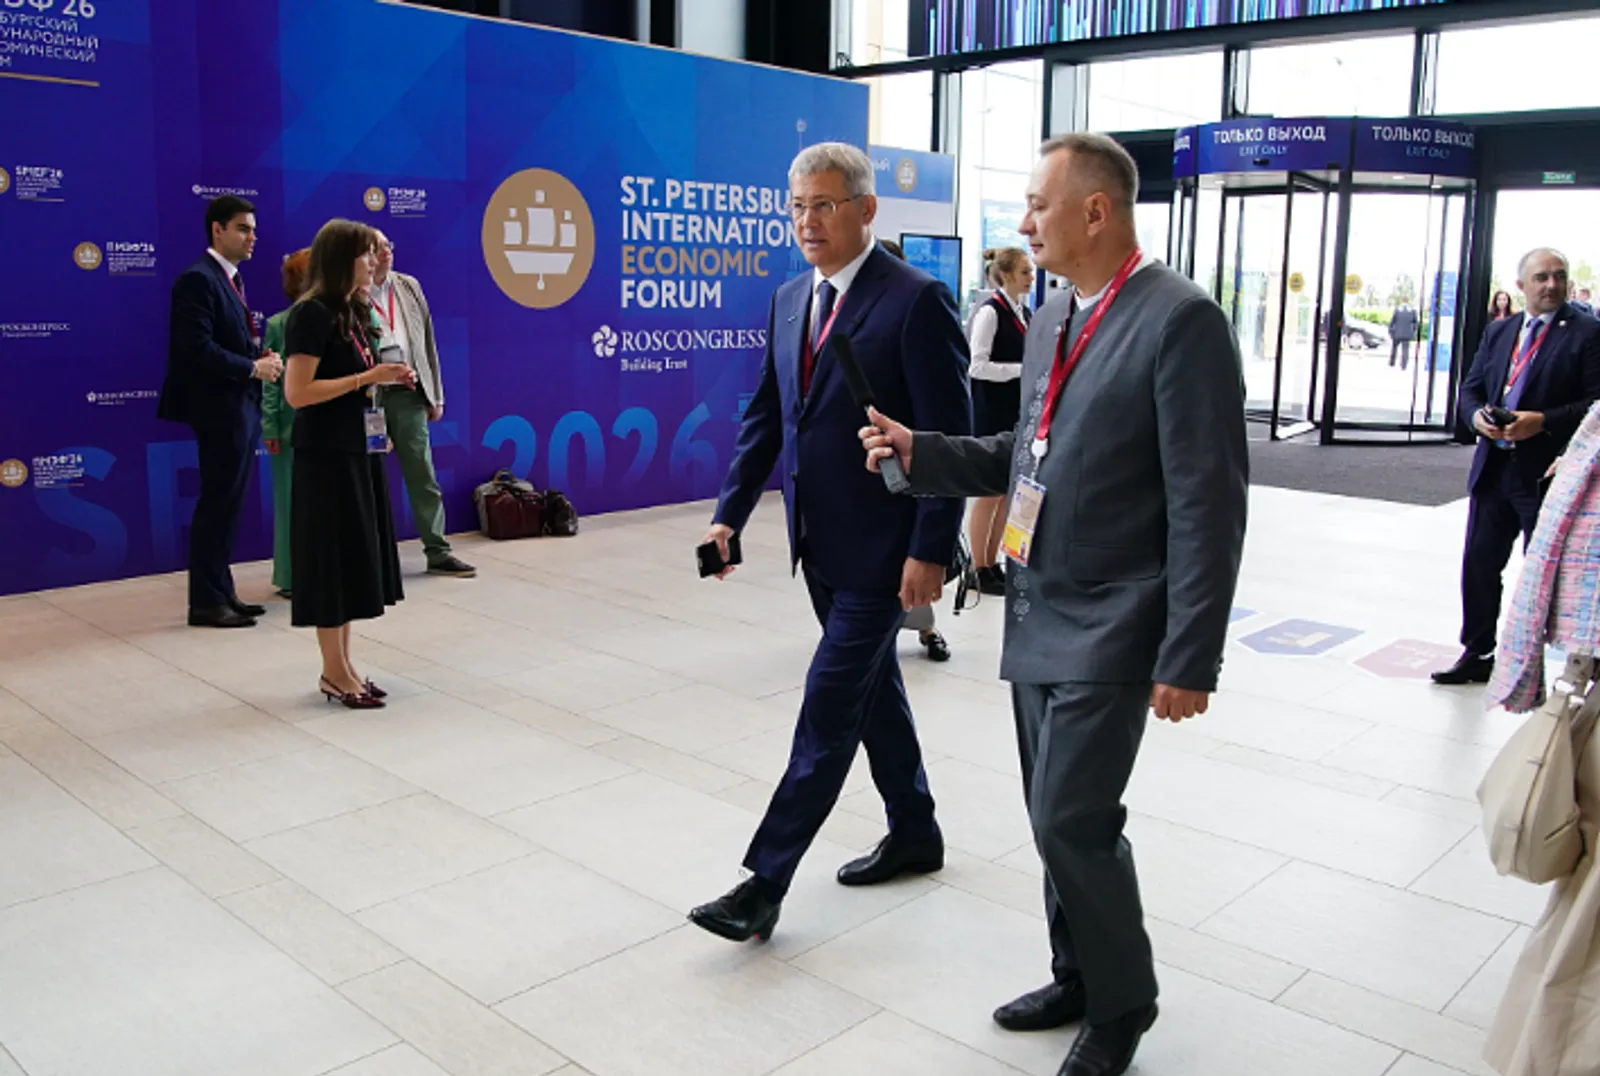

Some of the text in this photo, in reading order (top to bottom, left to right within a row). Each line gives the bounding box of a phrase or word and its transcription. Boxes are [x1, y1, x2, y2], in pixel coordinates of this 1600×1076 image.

[1213, 126, 1326, 144] ТОЛЬКО ВЫХОД
[1372, 126, 1431, 143] ТОЛЬКО
[620, 175, 793, 216] ST. PETERSBU
[621, 245, 769, 277] ECONOMIC
[621, 279, 722, 309] FORUM
[620, 329, 767, 352] ROSCONGRESS
[620, 357, 688, 373] Building Trust
[481, 401, 718, 502] 2026
